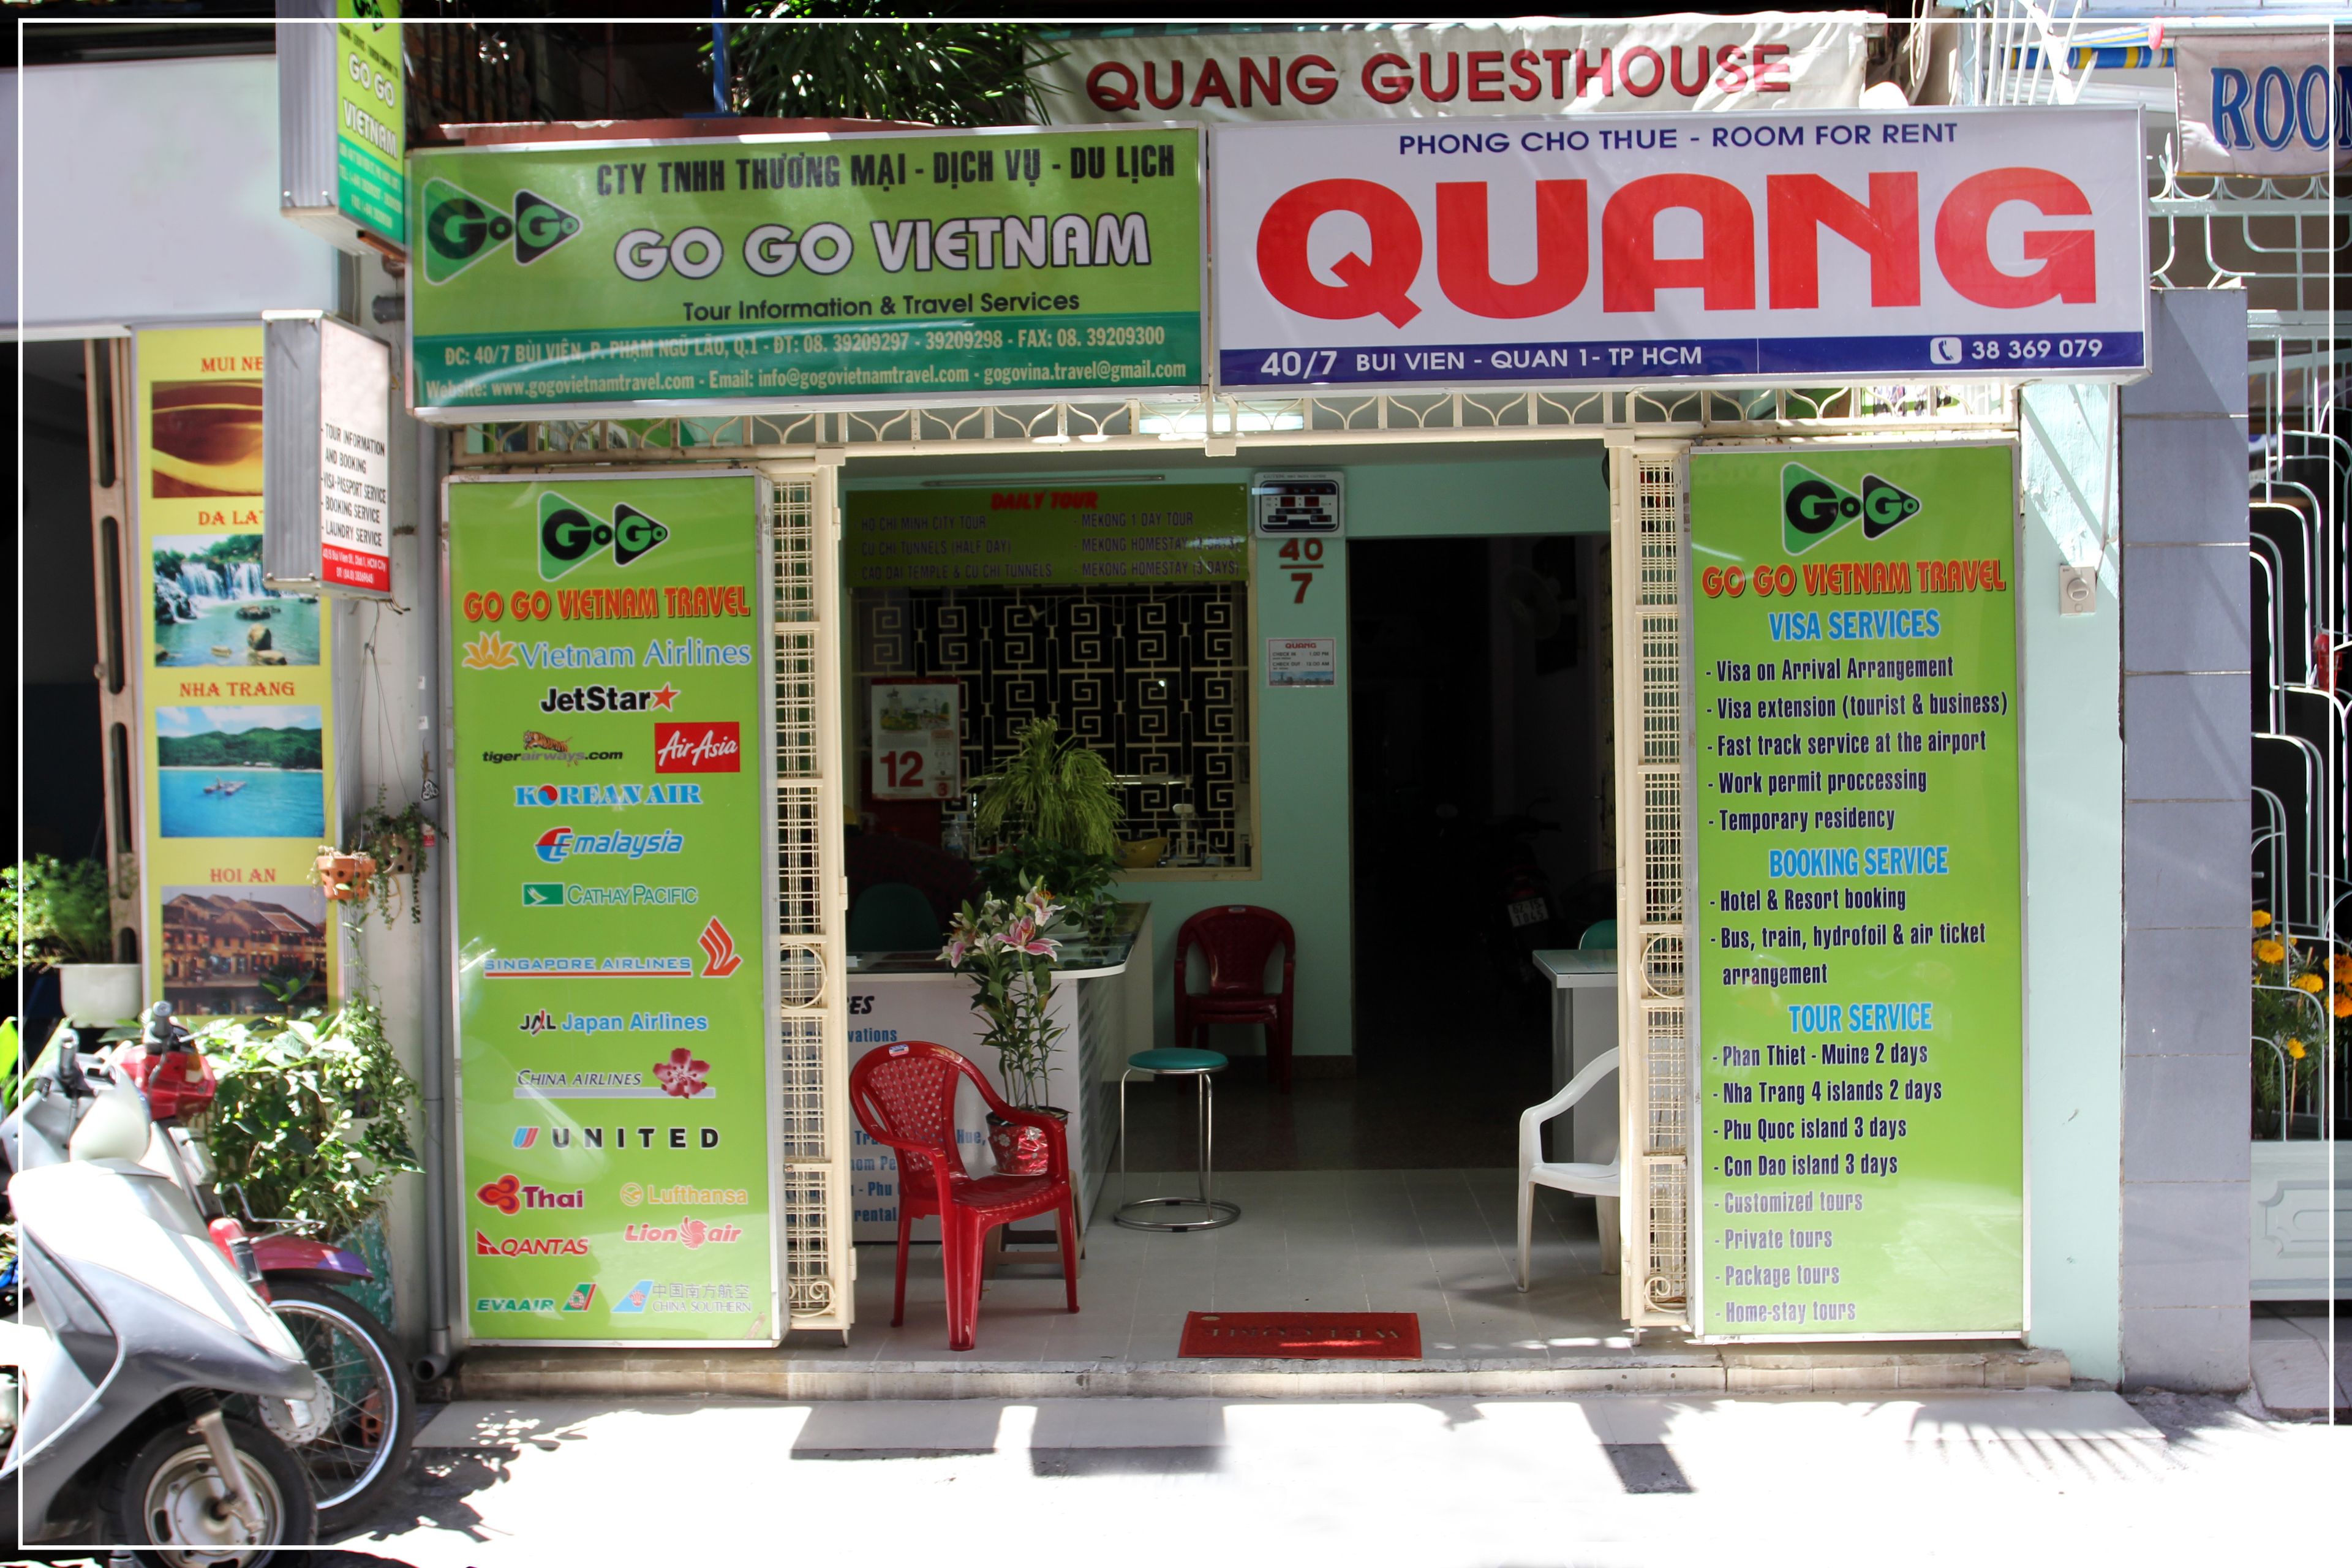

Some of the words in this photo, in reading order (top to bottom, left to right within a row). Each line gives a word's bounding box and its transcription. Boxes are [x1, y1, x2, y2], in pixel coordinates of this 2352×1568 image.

[348, 51, 371, 91] GO
[374, 70, 395, 108] GO
[1086, 54, 1339, 111] QUANG
[1361, 43, 1791, 103] GUESTHOUSE
[343, 97, 398, 160] VIETNAM
[1400, 132, 1510, 154] PHONG
[1520, 131, 1589, 151] CHO
[1599, 129, 1677, 149] THUE
[1713, 126, 1803, 148] ROOM
[1815, 125, 1871, 145] FOR
[1882, 123, 1958, 143] RENT
[597, 164, 646, 197] CTY
[658, 160, 725, 193] TNHH
[851, 153, 905, 192] MẠI
[933, 150, 993, 190] DỊCH
[1007, 148, 1041, 187] VỤ
[1071, 146, 1104, 179] DU
[1117, 144, 1174, 187] LỊCH
[615, 226, 723, 282] GO
[743, 221, 853, 277] GO
[871, 212, 1152, 273] VIETNAM
[1257, 166, 2096, 329] QUANG
[683, 302, 731, 322] Tour
[739, 298, 872, 320] Information
[880, 296, 896, 315] &
[903, 293, 973, 314] Travel
[981, 291, 1079, 313] Services
[474, 344, 509, 363] 40/7
[804, 334, 827, 353] 08.
[832, 333, 909, 352] 39209297
[925, 330, 1002, 350] 39209298
[1019, 328, 1052, 348] FAX:
[1057, 328, 1081, 347] 08.
[1087, 326, 1164, 345] 39209300
[1972, 341, 2000, 360] 38
[2008, 339, 2051, 359] 369
[2059, 339, 2102, 358] 079
[201, 357, 236, 372] MUI
[1260, 350, 1337, 379] 40/7
[1356, 354, 1396, 372] BUI
[1404, 352, 1464, 371] VIEN
[1491, 349, 1567, 369] QUAN
[1608, 347, 1634, 366] TP
[1642, 346, 1702, 366] HCM
[426, 378, 488, 399] Website:
[491, 371, 694, 398] www.gogovietnamtravel.com
[710, 369, 753, 389] Email:
[758, 364, 969, 389] info@gogovietnamtravel.com
[984, 360, 1186, 385] gogovina.travel@gmail.com
[325, 423, 341, 442] TOUR
[343, 429, 385, 457] INFORMATION
[325, 447, 337, 465] AND
[339, 451, 366, 475] BOOKING
[364, 484, 386, 504] SERVICE
[991, 491, 1043, 510] DAILY
[1050, 491, 1099, 509] TOUR
[198, 510, 225, 526] DA
[233, 510, 264, 525] LA
[325, 496, 352, 518] BOOKING
[353, 505, 380, 524] SERVICE
[1082, 513, 1127, 529] MEKONG
[1141, 512, 1162, 527] DAY
[1167, 511, 1194, 527] TOUR
[326, 520, 353, 540] LAUNDRY
[355, 528, 382, 547] SERVICE
[1769, 611, 1822, 641] VISA
[1828, 609, 1940, 640] SERVICES
[519, 642, 634, 669] Vietnam
[643, 637, 751, 666] Airlines
[1717, 661, 1750, 682] Visa
[1757, 663, 1776, 681] on
[1782, 658, 1841, 680] Arrival
[1847, 657, 1953, 680] Arrangement
[179, 682, 221, 697] NHA
[228, 682, 295, 696] TRANG
[541, 685, 650, 713] JetStar
[880, 750, 924, 788] 12
[1719, 772, 1762, 794] Work
[1769, 771, 1822, 796] permit
[1828, 768, 1927, 795] proccessing
[514, 785, 641, 807] KOREAN
[645, 783, 702, 804] AIR
[573, 829, 683, 859] malaysia
[209, 868, 241, 883] HOI
[249, 868, 276, 883] AN
[1769, 848, 1858, 878] BOOKING
[1864, 846, 1949, 875] SERVICE
[484, 957, 595, 970] SINGAPORE
[601, 957, 692, 970] AIRLINES
[519, 1009, 556, 1035] JAL
[562, 1014, 623, 1034] Japan
[629, 1012, 708, 1031] Airlines
[1789, 1005, 1842, 1033] TOUR
[1849, 1002, 1934, 1031] SERVICE
[1723, 1046, 1760, 1068] Phan
[1767, 1044, 1806, 1066] Thiet
[1822, 1043, 1869, 1065] Muine
[1875, 1042, 1884, 1064] 2
[1891, 1042, 1928, 1066] days
[517, 1069, 566, 1086] CHINA
[571, 1072, 642, 1085] AIRLINES
[552, 1127, 719, 1149] UNITED
[647, 1184, 748, 1205] Lufthansa
[500, 1237, 589, 1257] QANTAS
[624, 1224, 677, 1243] Lion
[704, 1224, 742, 1243] air
[1725, 1229, 1784, 1250] Private
[1789, 1229, 1833, 1250] tours
[652, 1300, 687, 1313] CHINA
[691, 1300, 752, 1313] SOUTHERN
[1725, 1301, 1806, 1325] Home-stay
[1813, 1301, 1856, 1321] tours
